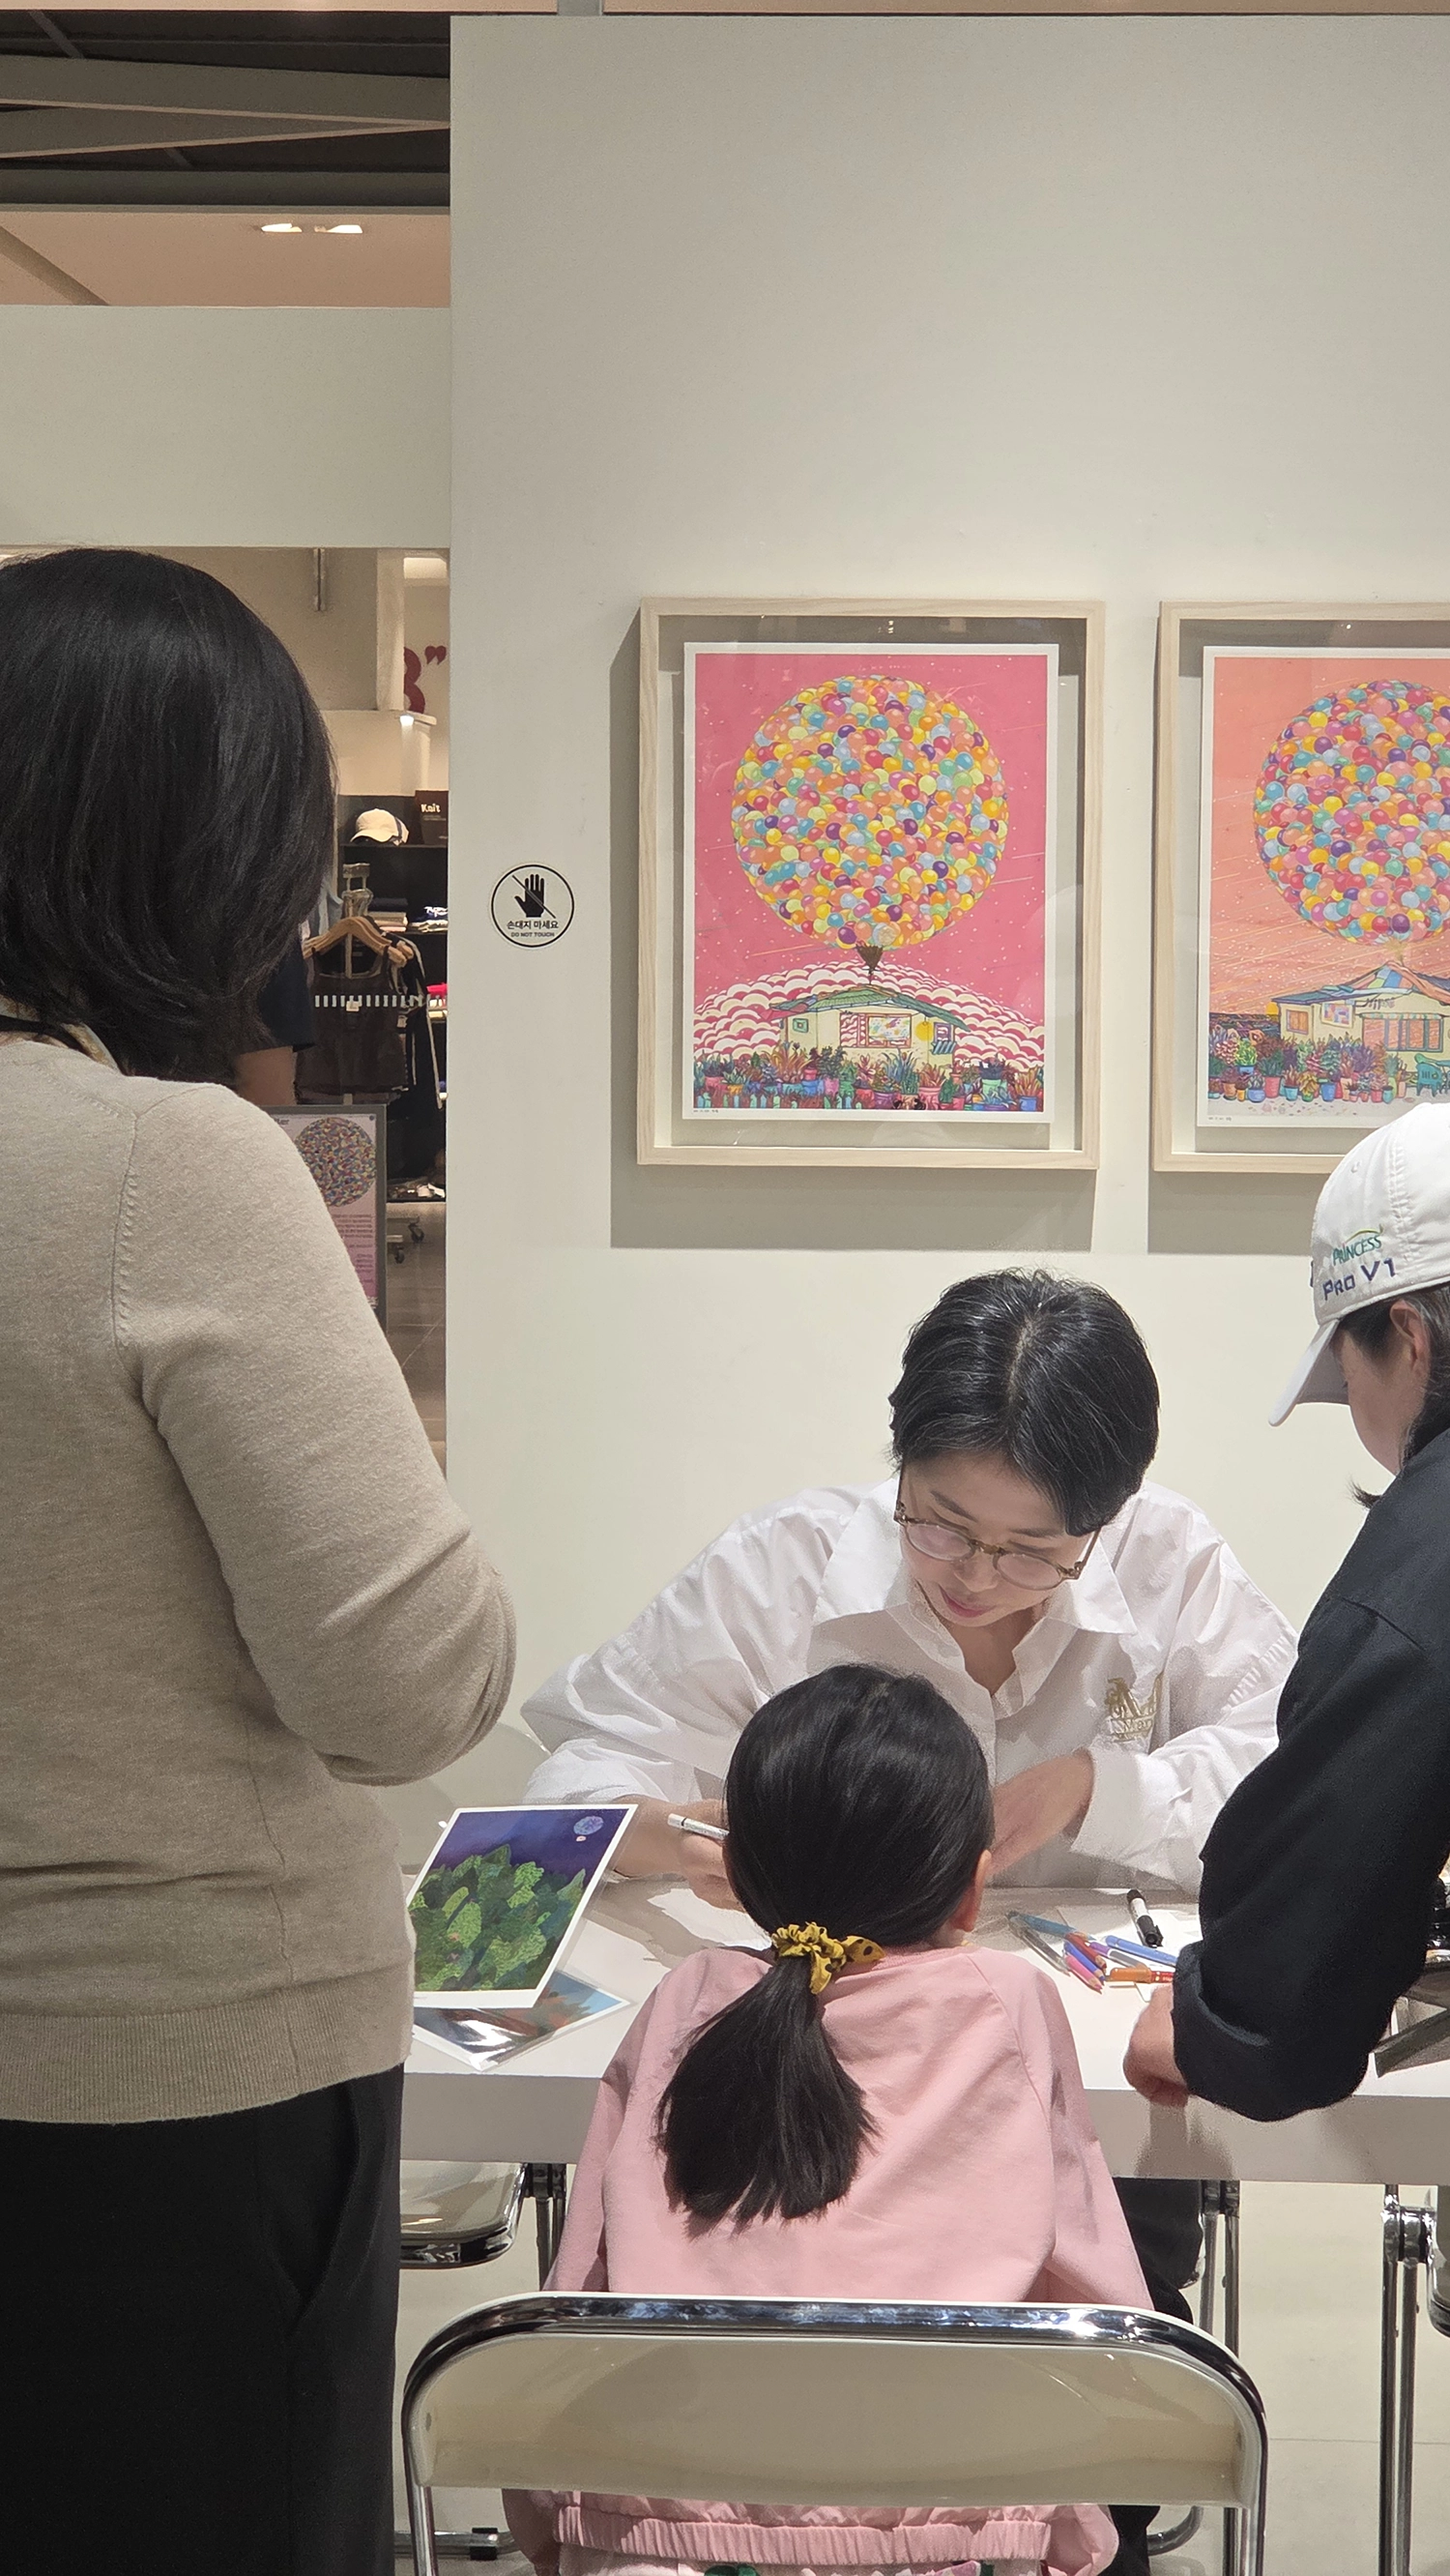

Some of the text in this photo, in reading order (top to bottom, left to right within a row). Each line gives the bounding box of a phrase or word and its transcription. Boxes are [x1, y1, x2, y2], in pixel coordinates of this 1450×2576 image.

[507, 920, 559, 930] 손대지 마세요
[1332, 1234, 1382, 1267] PRINCESS
[1321, 1273, 1356, 1301] PRO
[1360, 1257, 1396, 1282] V1
